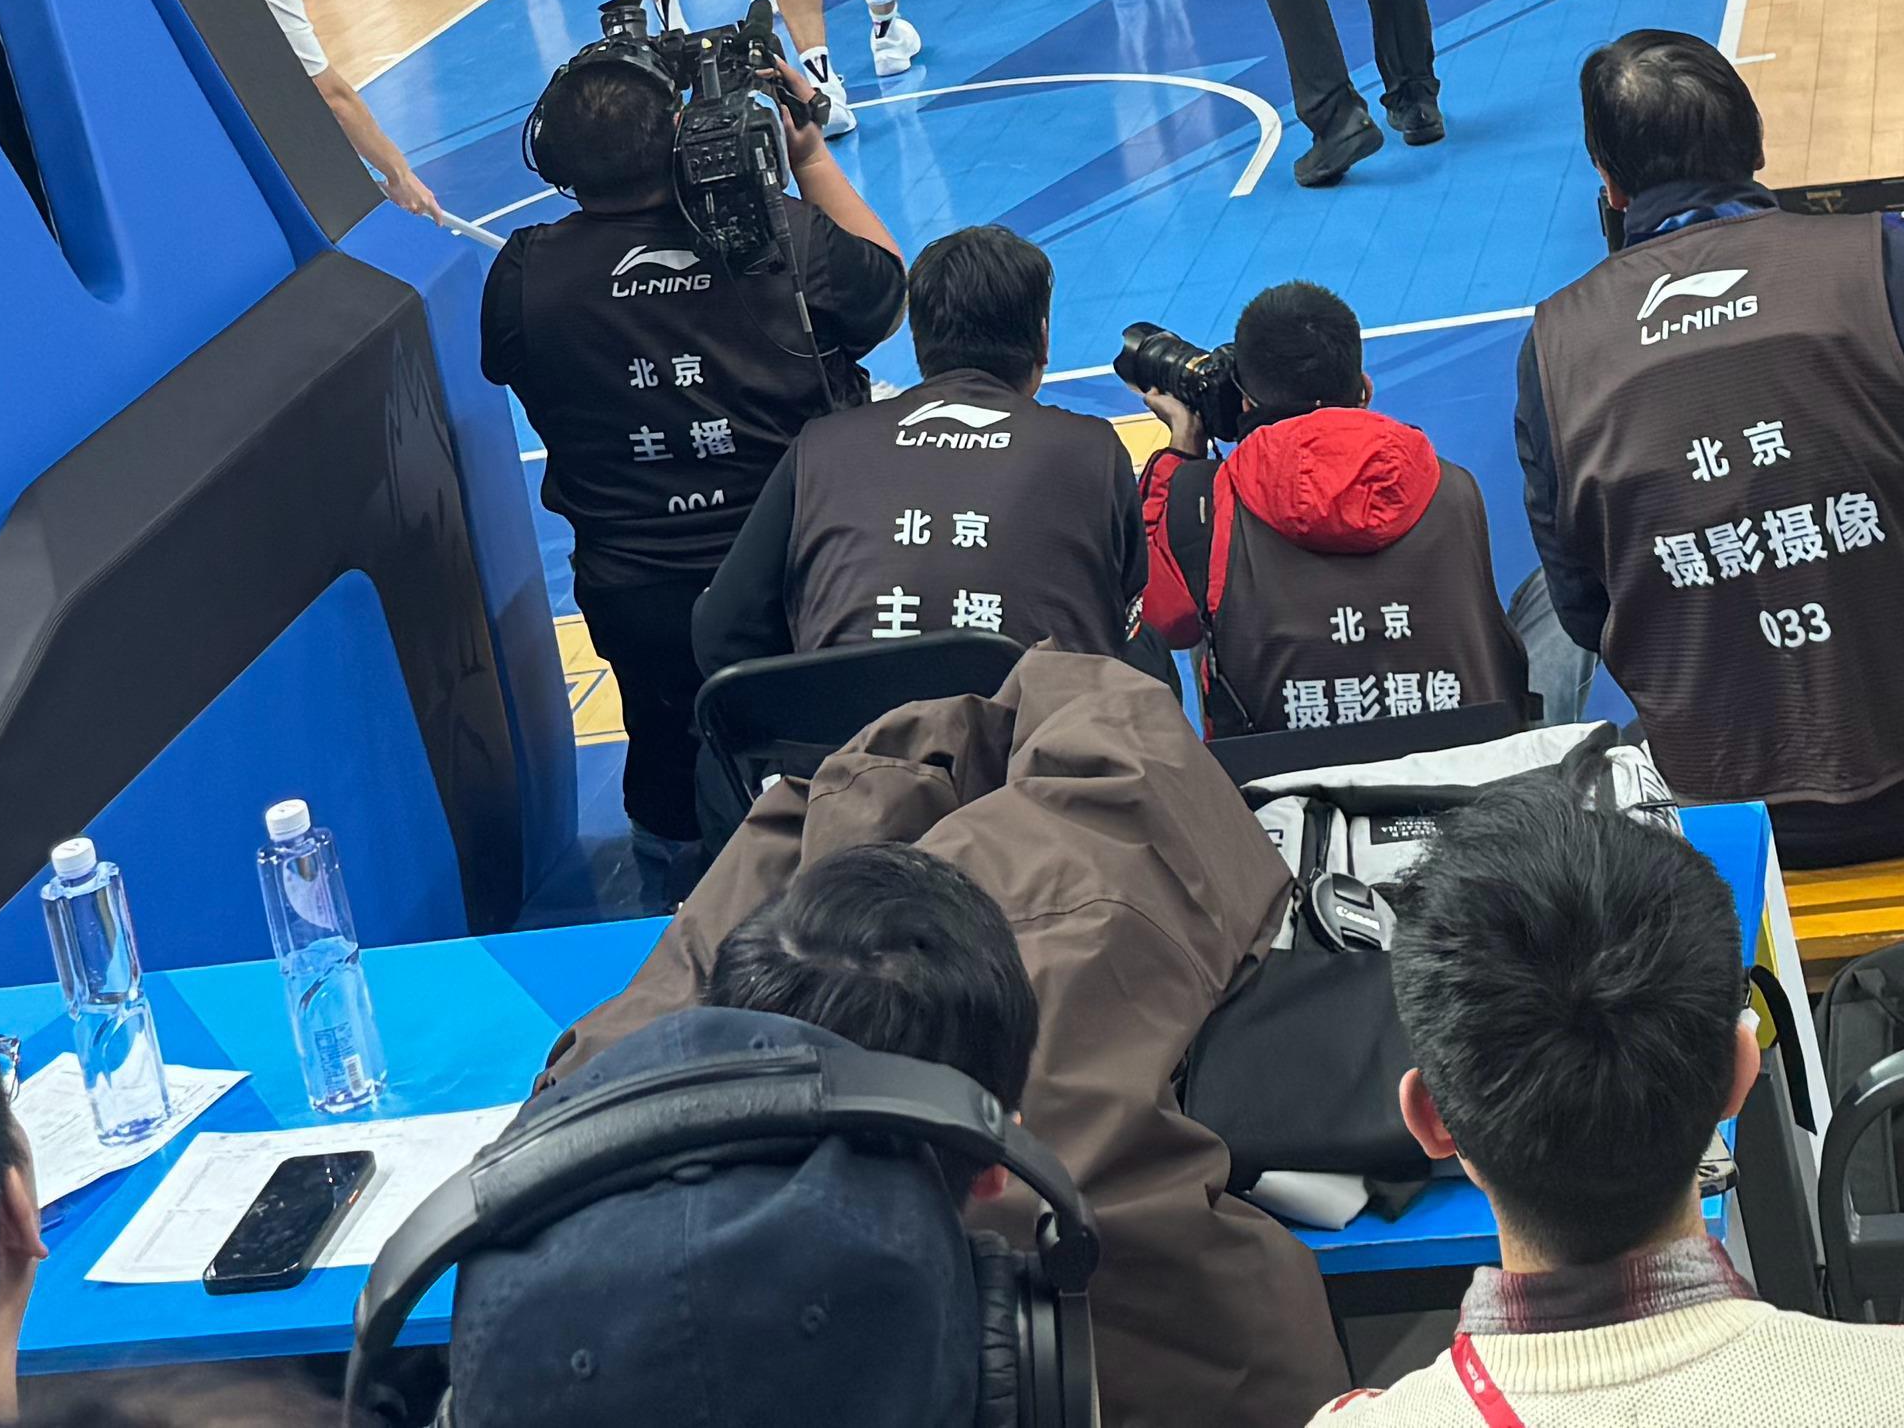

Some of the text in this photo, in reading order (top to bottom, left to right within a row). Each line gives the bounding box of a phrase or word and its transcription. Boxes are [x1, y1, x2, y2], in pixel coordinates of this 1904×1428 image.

[611, 269, 712, 299] LI-NING
[1639, 294, 1759, 346] LI-NING
[626, 351, 705, 390] 北京
[628, 418, 736, 463] 主播
[895, 423, 1013, 451] LI-NING
[1686, 419, 1791, 482] 北京
[894, 508, 990, 549] 北京
[1653, 490, 1887, 591] 摄影摄像
[872, 586, 1004, 641] 主播
[1330, 601, 1414, 646] 北京
[1758, 600, 1832, 651] 033
[1282, 668, 1463, 731] 摄影摄像
